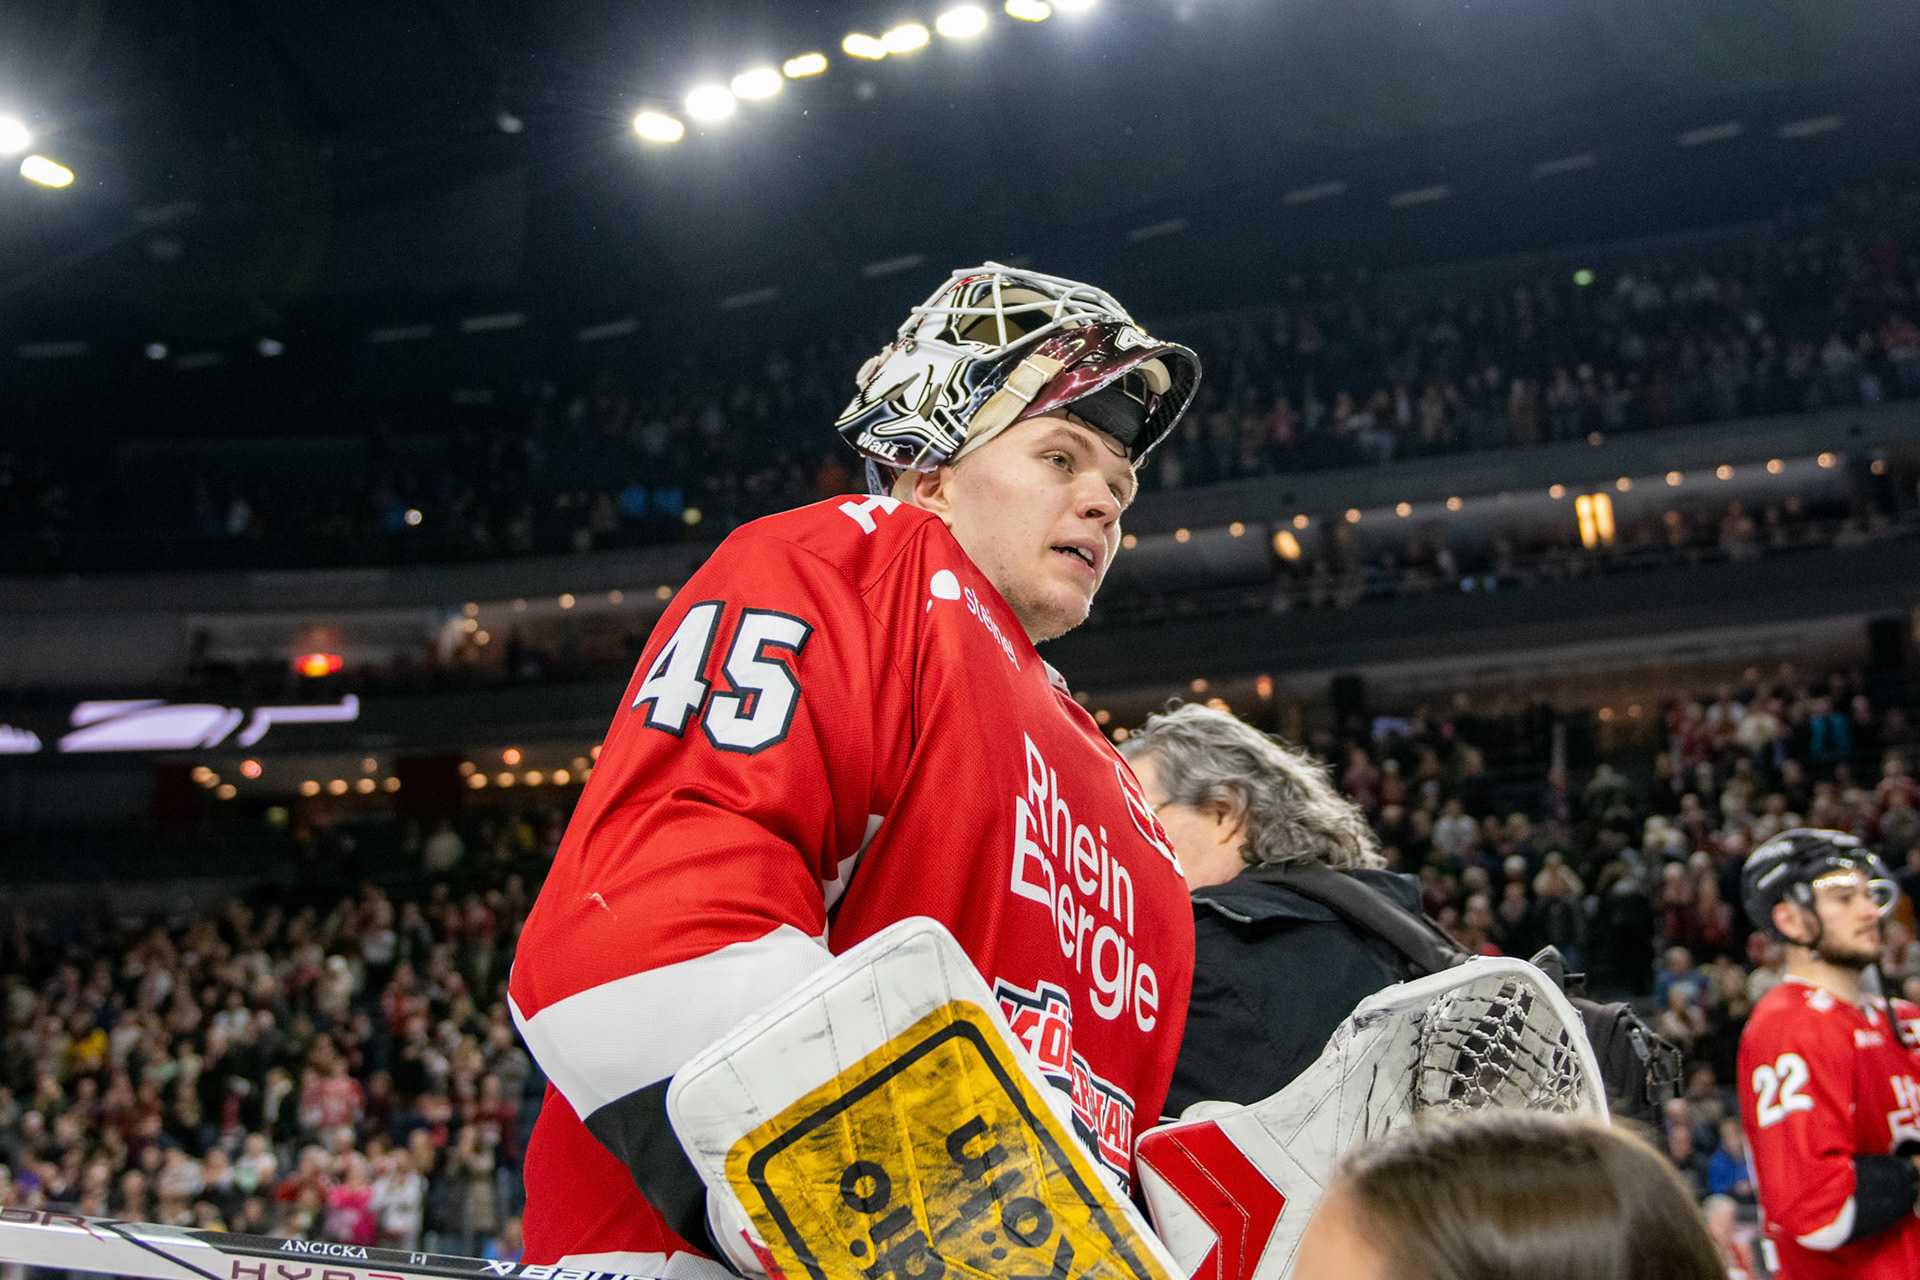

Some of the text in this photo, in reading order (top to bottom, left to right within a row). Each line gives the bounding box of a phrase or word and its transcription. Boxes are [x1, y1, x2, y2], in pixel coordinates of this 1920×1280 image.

[629, 600, 815, 756] 45
[1024, 731, 1134, 938] Rhein
[1010, 795, 1159, 1032] Energie
[1752, 1053, 1814, 1127] 22
[280, 1239, 369, 1259] ANCICKA
